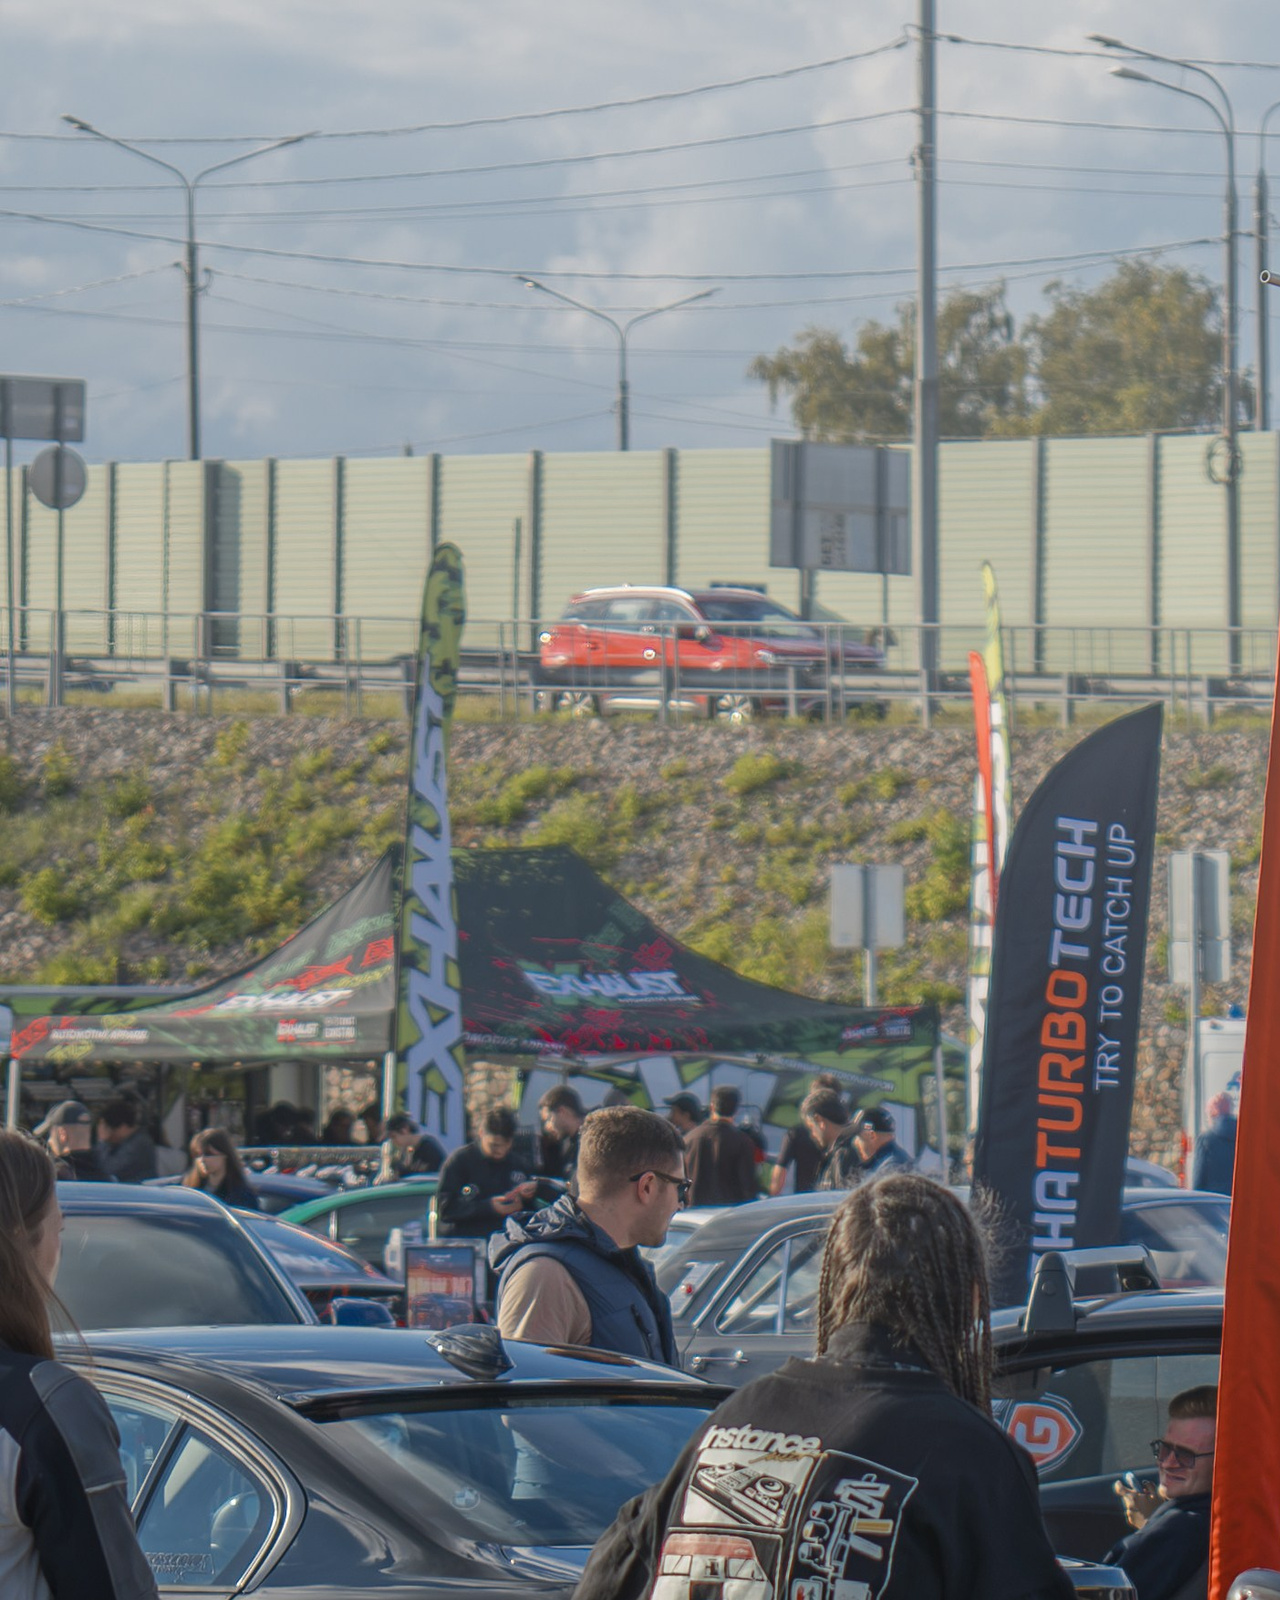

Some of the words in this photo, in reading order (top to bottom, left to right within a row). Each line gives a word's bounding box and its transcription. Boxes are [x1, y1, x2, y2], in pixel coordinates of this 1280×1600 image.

[1106, 822, 1137, 868] UP
[406, 651, 465, 1158] EXHAUST
[1101, 876, 1132, 974] CATCH
[1100, 984, 1124, 1023] TO
[1030, 816, 1099, 1275] HATURBOTECH
[1095, 1034, 1121, 1091] TRY
[699, 1423, 822, 1453] Instance
